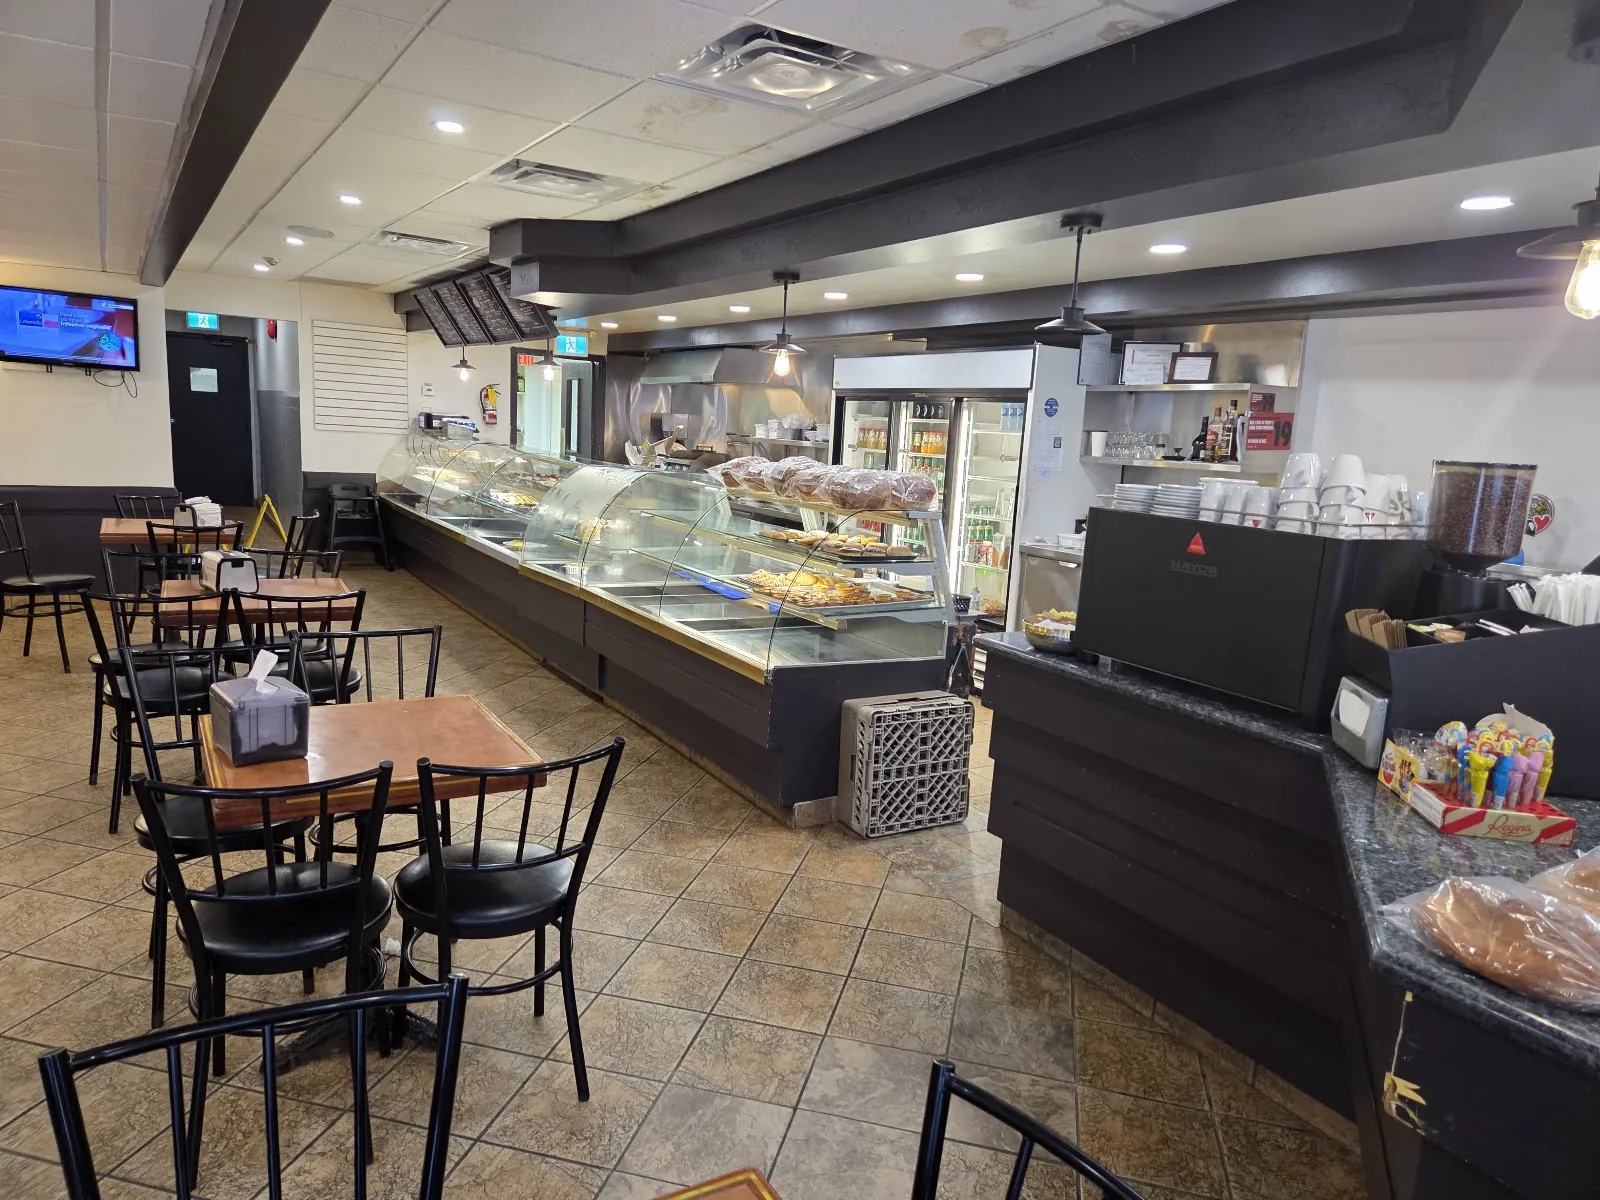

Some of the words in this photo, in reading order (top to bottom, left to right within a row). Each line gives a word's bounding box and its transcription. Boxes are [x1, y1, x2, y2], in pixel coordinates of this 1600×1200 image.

[518, 354, 535, 364] EXIT
[1274, 421, 1292, 447] 19
[1170, 560, 1217, 576] MAYOR
[1483, 814, 1534, 838] Regina
